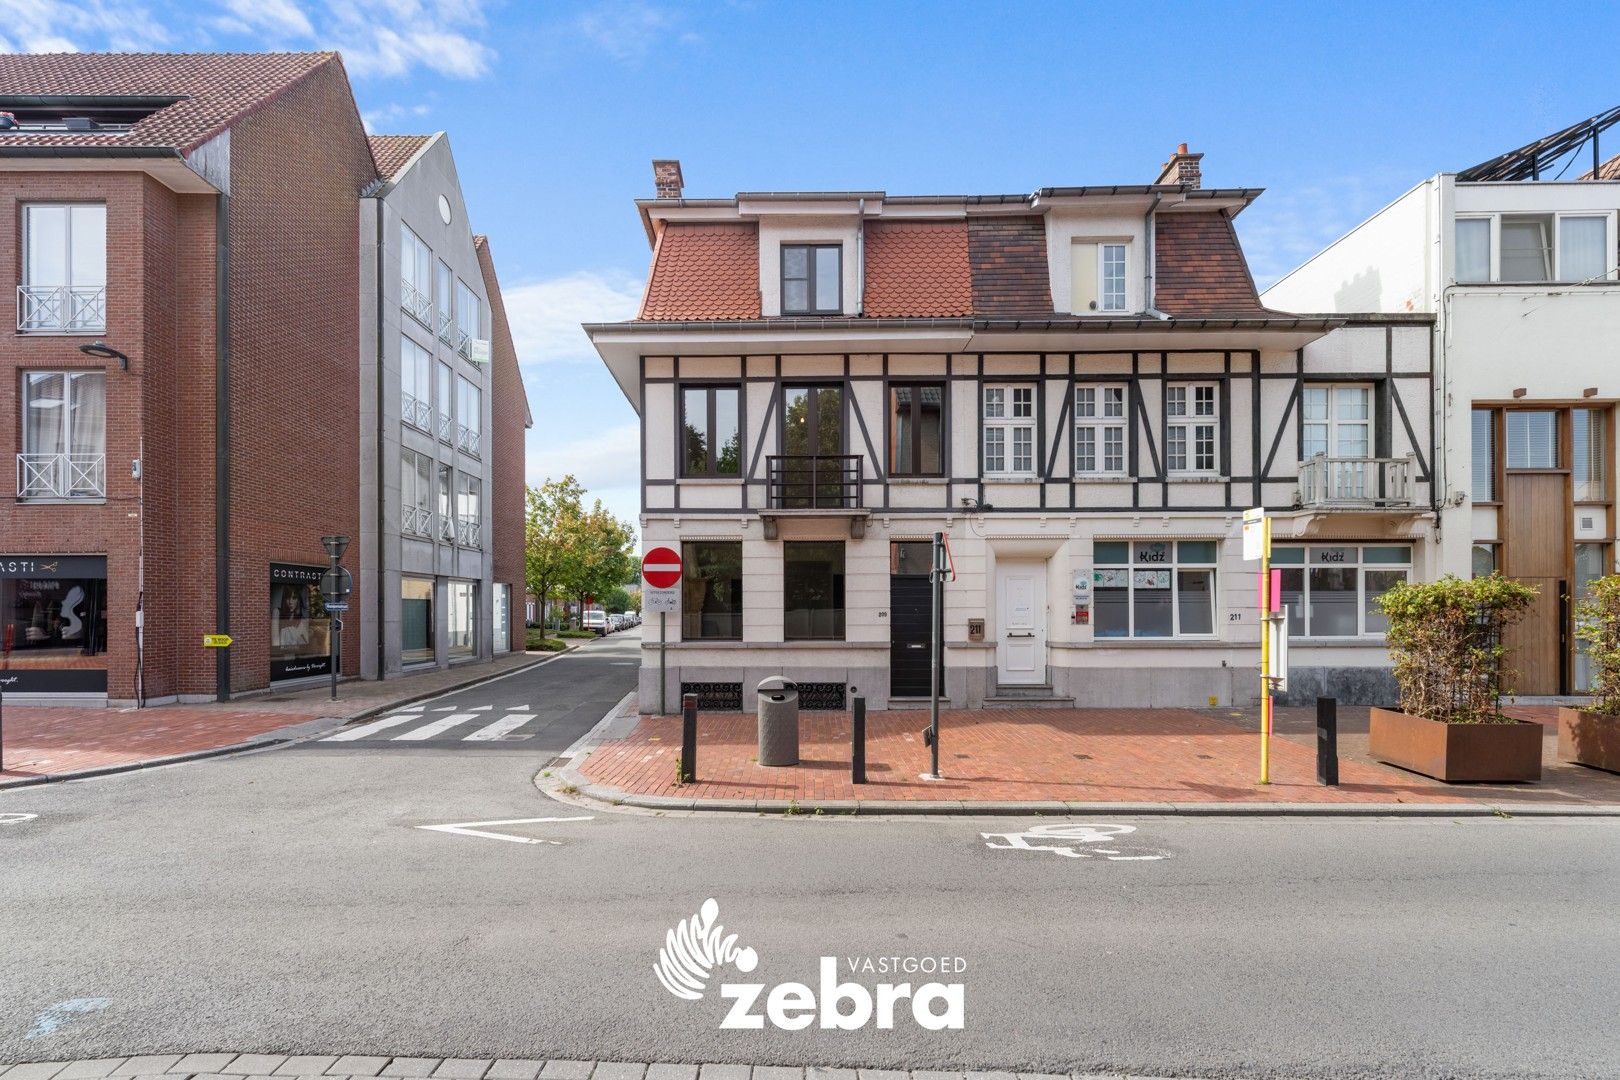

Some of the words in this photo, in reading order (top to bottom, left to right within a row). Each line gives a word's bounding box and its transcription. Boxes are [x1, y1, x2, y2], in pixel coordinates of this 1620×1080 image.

[1139, 551, 1166, 562] Kidz
[1321, 551, 1345, 562] Kidz
[1229, 613, 1241, 621] 211
[969, 624, 982, 635] 211
